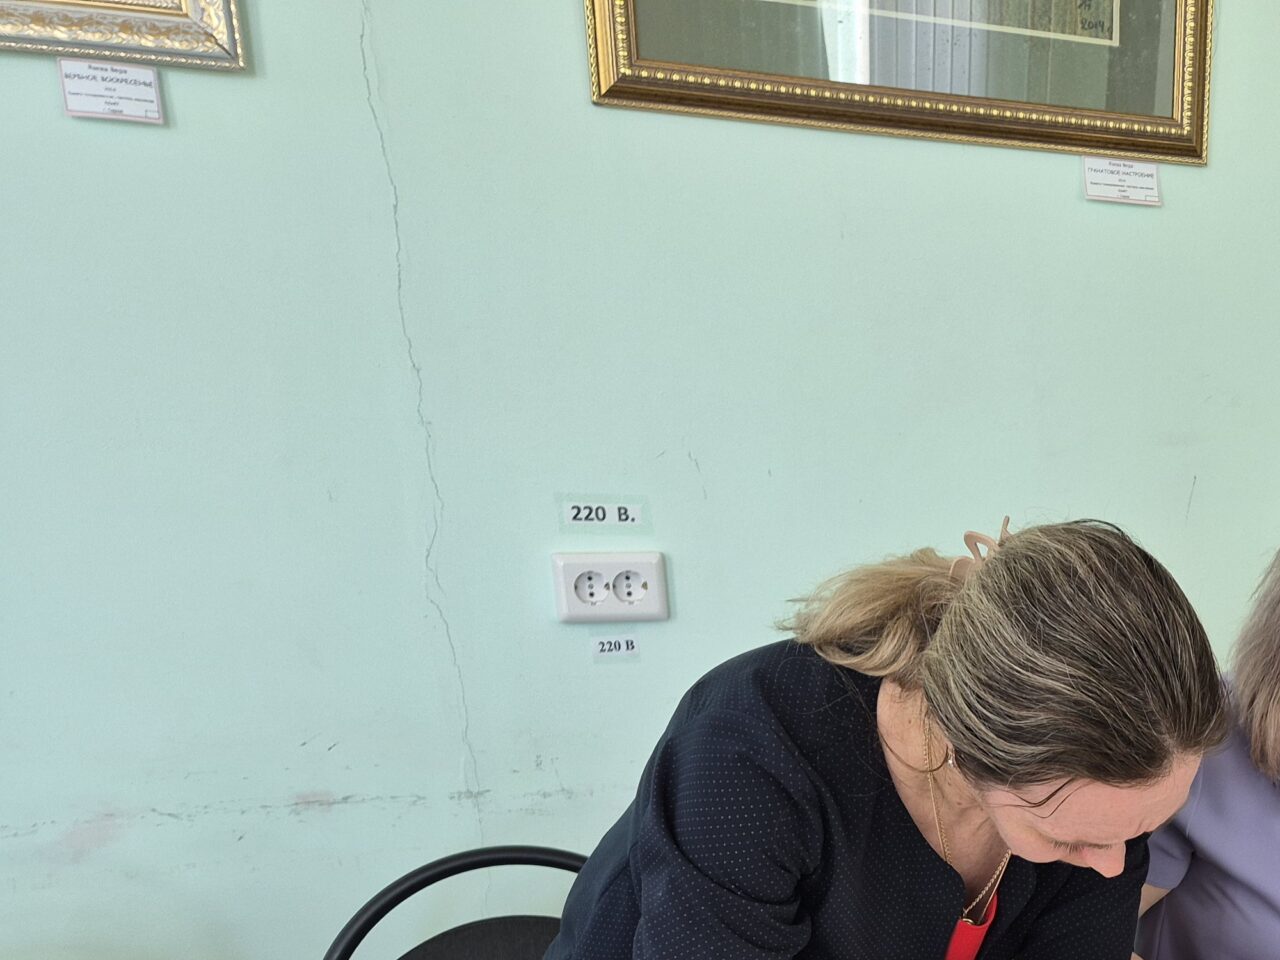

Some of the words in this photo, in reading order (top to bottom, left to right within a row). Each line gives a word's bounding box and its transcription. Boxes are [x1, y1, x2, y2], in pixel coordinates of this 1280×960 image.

[571, 505, 606, 522] 220
[618, 506, 636, 522] В.
[598, 640, 621, 653] 220
[625, 640, 635, 651] В
